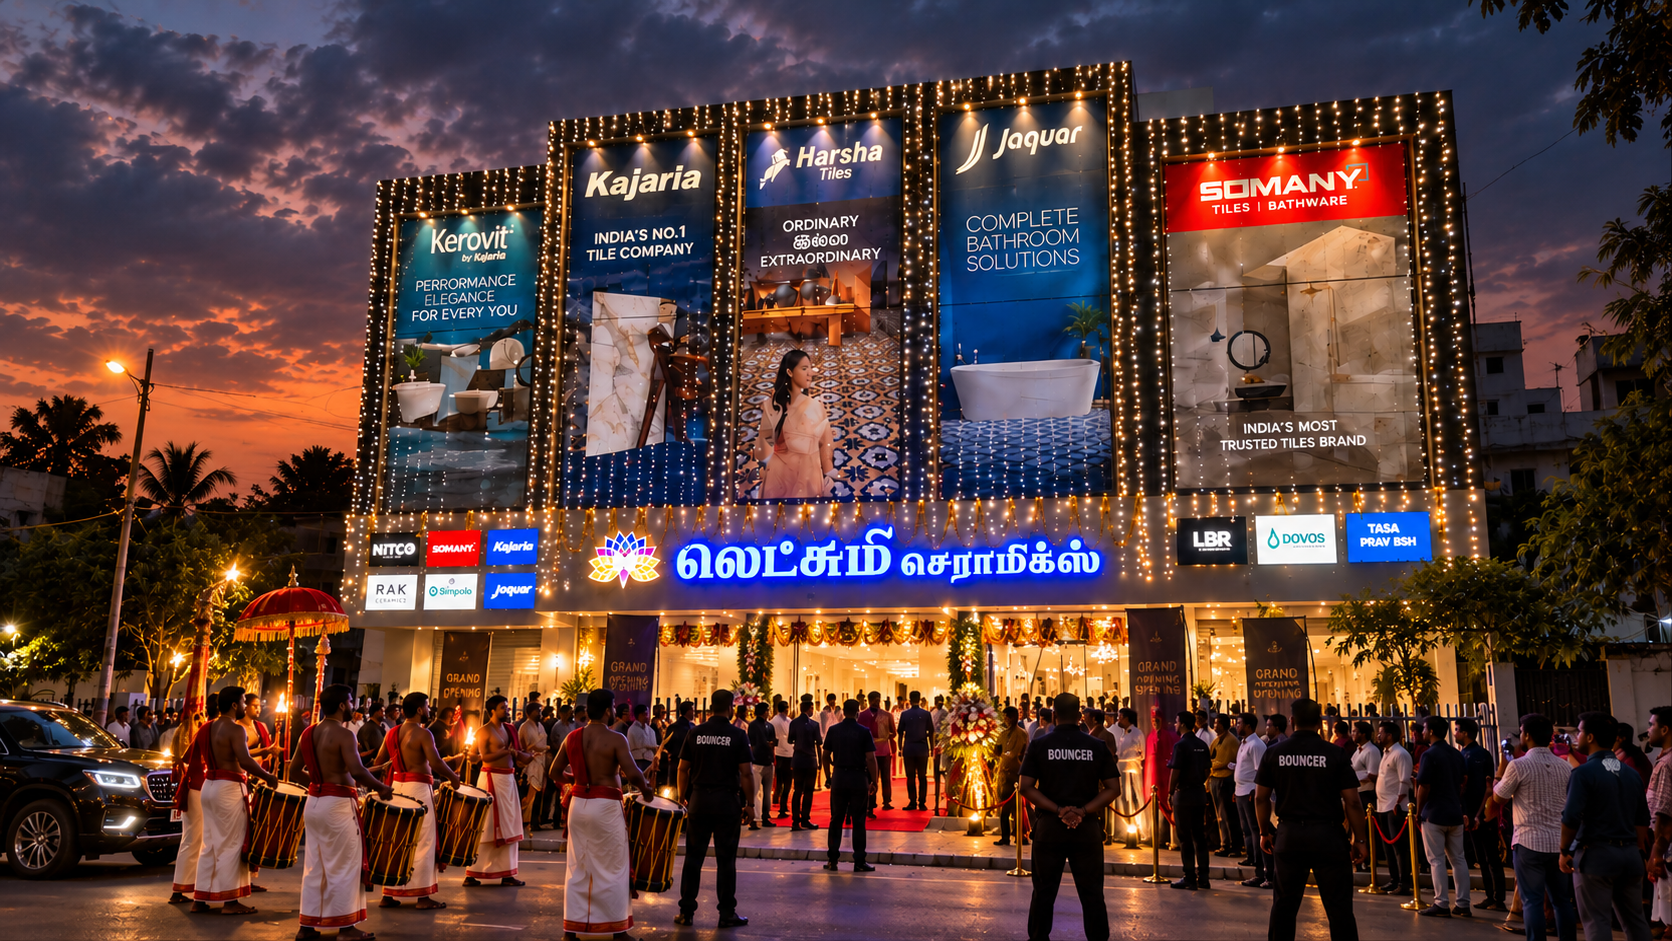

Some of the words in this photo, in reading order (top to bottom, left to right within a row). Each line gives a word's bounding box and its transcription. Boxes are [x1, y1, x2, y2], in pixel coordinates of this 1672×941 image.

[992, 125, 1083, 160] Jaquar
[795, 141, 883, 168] Harsha
[819, 167, 852, 181] Tiles
[584, 165, 702, 202] Kajaria
[1200, 168, 1362, 202] SOMANY
[1211, 202, 1250, 215] TILES
[1268, 195, 1348, 211] BATHWARE
[782, 215, 859, 232] ORDINARY
[966, 207, 1079, 233] COMPLETE
[431, 225, 508, 254] Kerovit
[594, 229, 648, 245] INDIA'S
[652, 225, 686, 240] NO.1
[966, 228, 1080, 253] BATHROOM
[461, 254, 473, 263] by
[473, 250, 506, 263] Kajaria
[586, 247, 616, 262] TILE
[619, 242, 694, 259] COMPANY
[760, 247, 881, 268] EXTRAORDINARY
[966, 248, 1080, 272] SOLUTIONS
[425, 290, 495, 306] ELEGANCE
[412, 309, 438, 321] FOR
[442, 306, 484, 320] EVERY
[488, 304, 518, 317] YOU
[1243, 421, 1294, 434] INDIA'S
[1298, 419, 1338, 433] MOST
[1220, 438, 1278, 451] TRUSTED
[1280, 437, 1315, 449] TILES
[1319, 434, 1367, 447] BRAND
[1367, 522, 1400, 534] TASA
[1193, 530, 1233, 548] LBR
[1282, 533, 1325, 544] DOVOS
[1360, 537, 1392, 547] PRAV
[1393, 536, 1417, 547] BSH
[372, 542, 416, 556] NITCO
[432, 544, 474, 553] SOMANY
[900, 539, 1100, 583] செராமிக்ஸ்
[376, 584, 407, 595] RAK
[439, 586, 472, 597] Simpolo
[696, 735, 731, 747] BOUNCER
[1047, 748, 1094, 761] BOUNCER
[1278, 754, 1327, 768] BOUNCER
